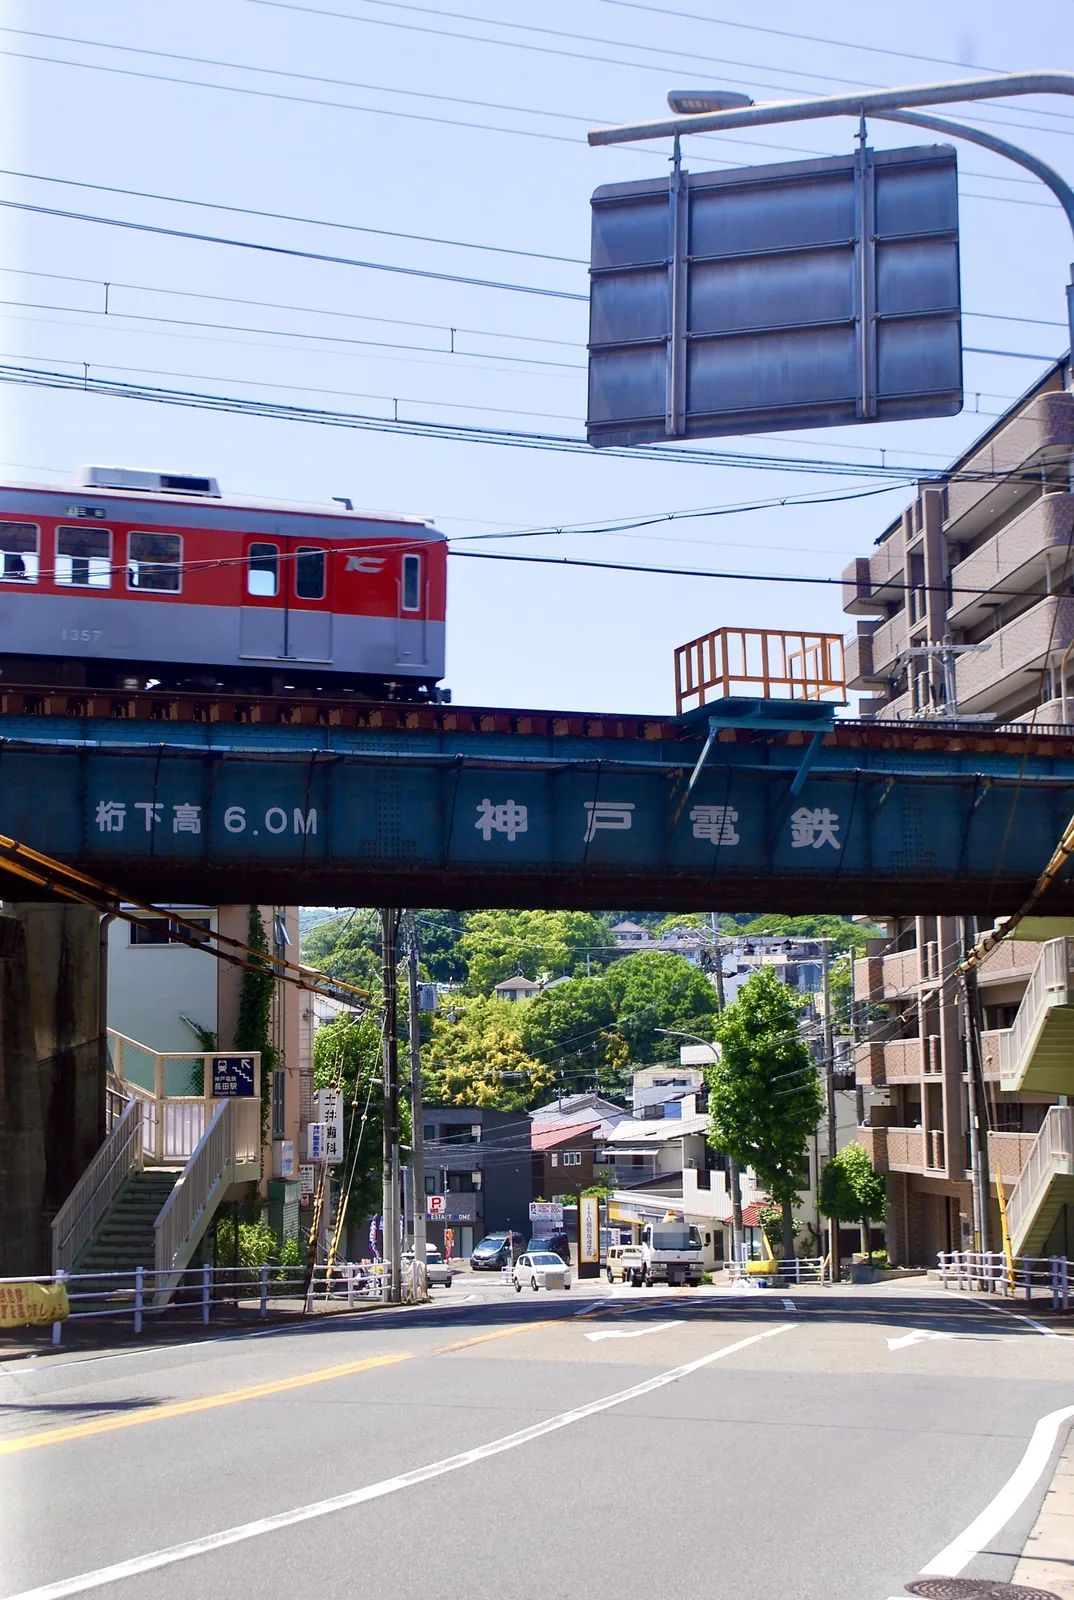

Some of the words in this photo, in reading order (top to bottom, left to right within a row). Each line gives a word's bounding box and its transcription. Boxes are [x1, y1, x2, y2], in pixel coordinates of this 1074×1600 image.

[61, 628, 102, 641] 1357
[95, 800, 202, 834] 桁下高
[223, 806, 318, 836] 6.0M
[475, 798, 842, 850] 神戸電鉄
[431, 1197, 442, 1208] P
